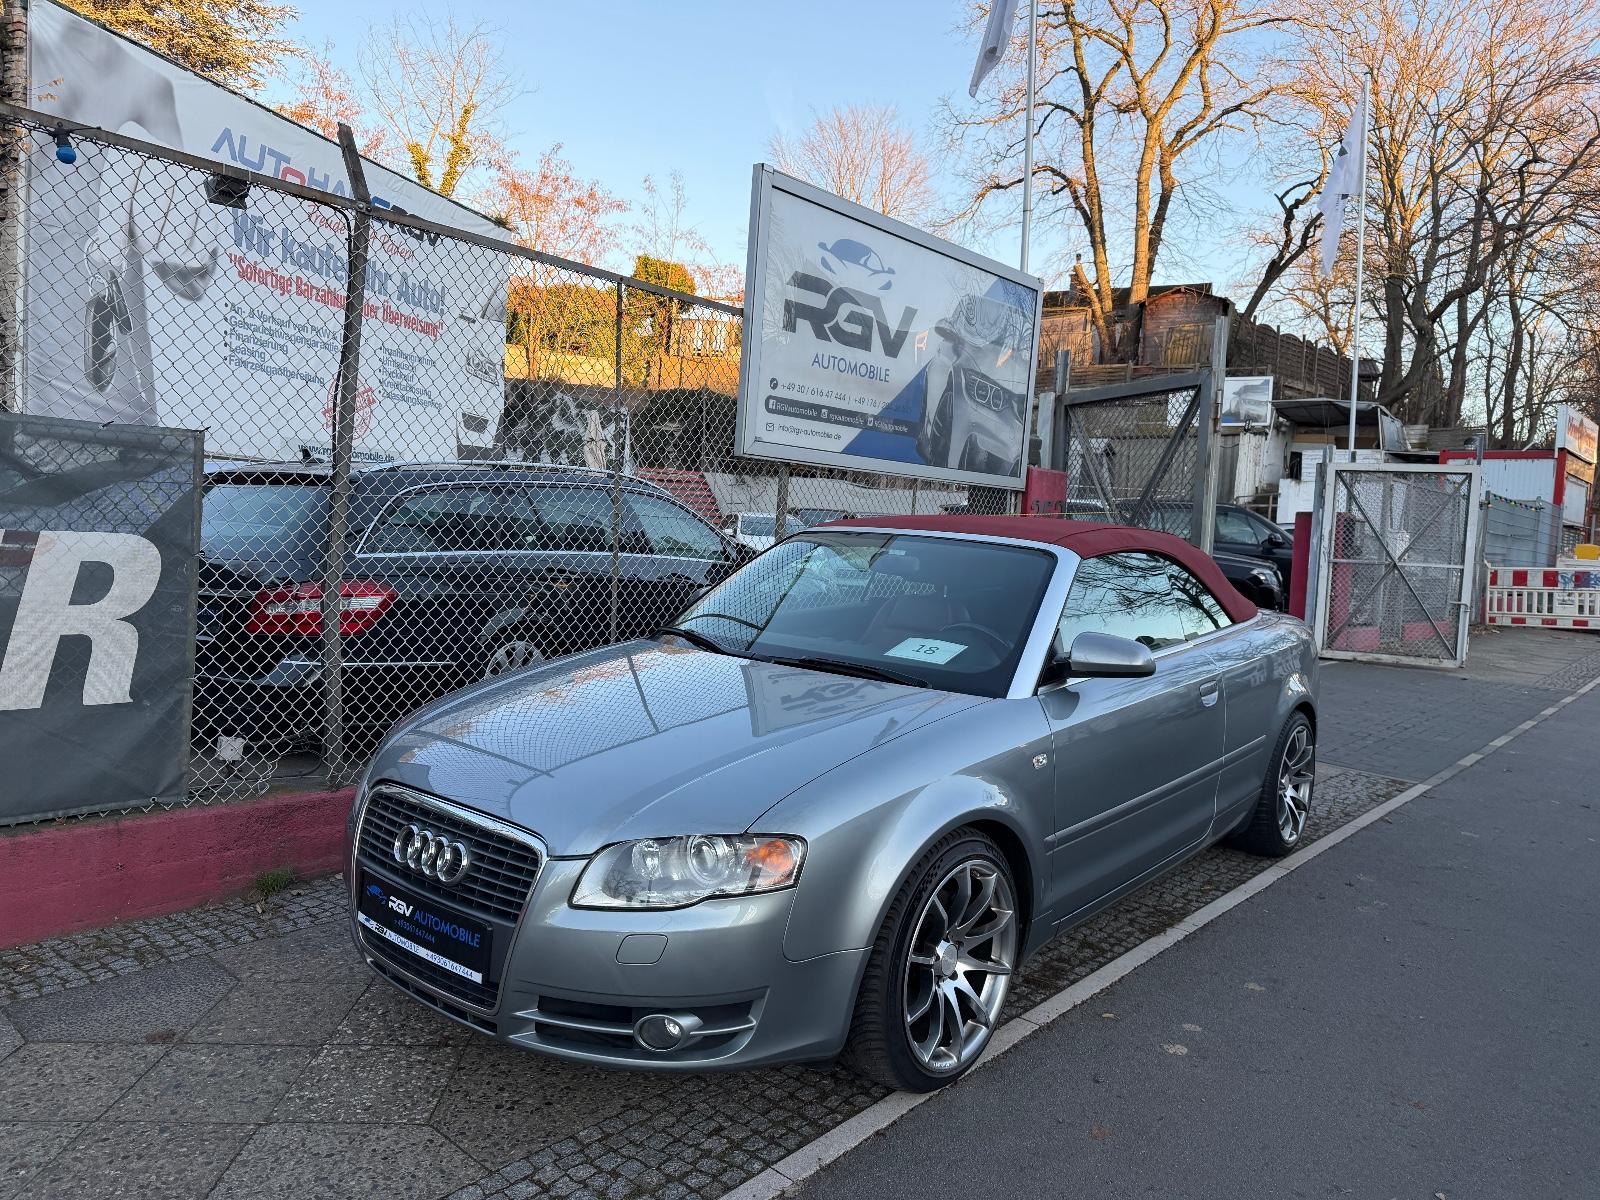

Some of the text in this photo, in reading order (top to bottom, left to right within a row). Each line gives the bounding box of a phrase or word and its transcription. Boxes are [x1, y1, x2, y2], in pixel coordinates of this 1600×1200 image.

[232, 207, 275, 257] Wir
[281, 227, 348, 283] kaufe
[397, 270, 446, 316] Auto!
[256, 309, 291, 327] Verkauf
[310, 325, 331, 339] PKW
[782, 270, 919, 358] RGV
[229, 327, 289, 355] Finanzierung
[229, 341, 266, 362] Leasing
[228, 355, 325, 387] Fahrzeugaufbereitung
[811, 352, 891, 383] AUTOMOBILE
[780, 382, 796, 392] +49
[796, 384, 806, 395] 30
[810, 387, 824, 398] 616
[825, 390, 834, 400] 47
[834, 391, 847, 402] 444
[0, 528, 162, 711] R
[911, 644, 940, 655] 18
[388, 895, 481, 948] RGV AUTOMOBILE
